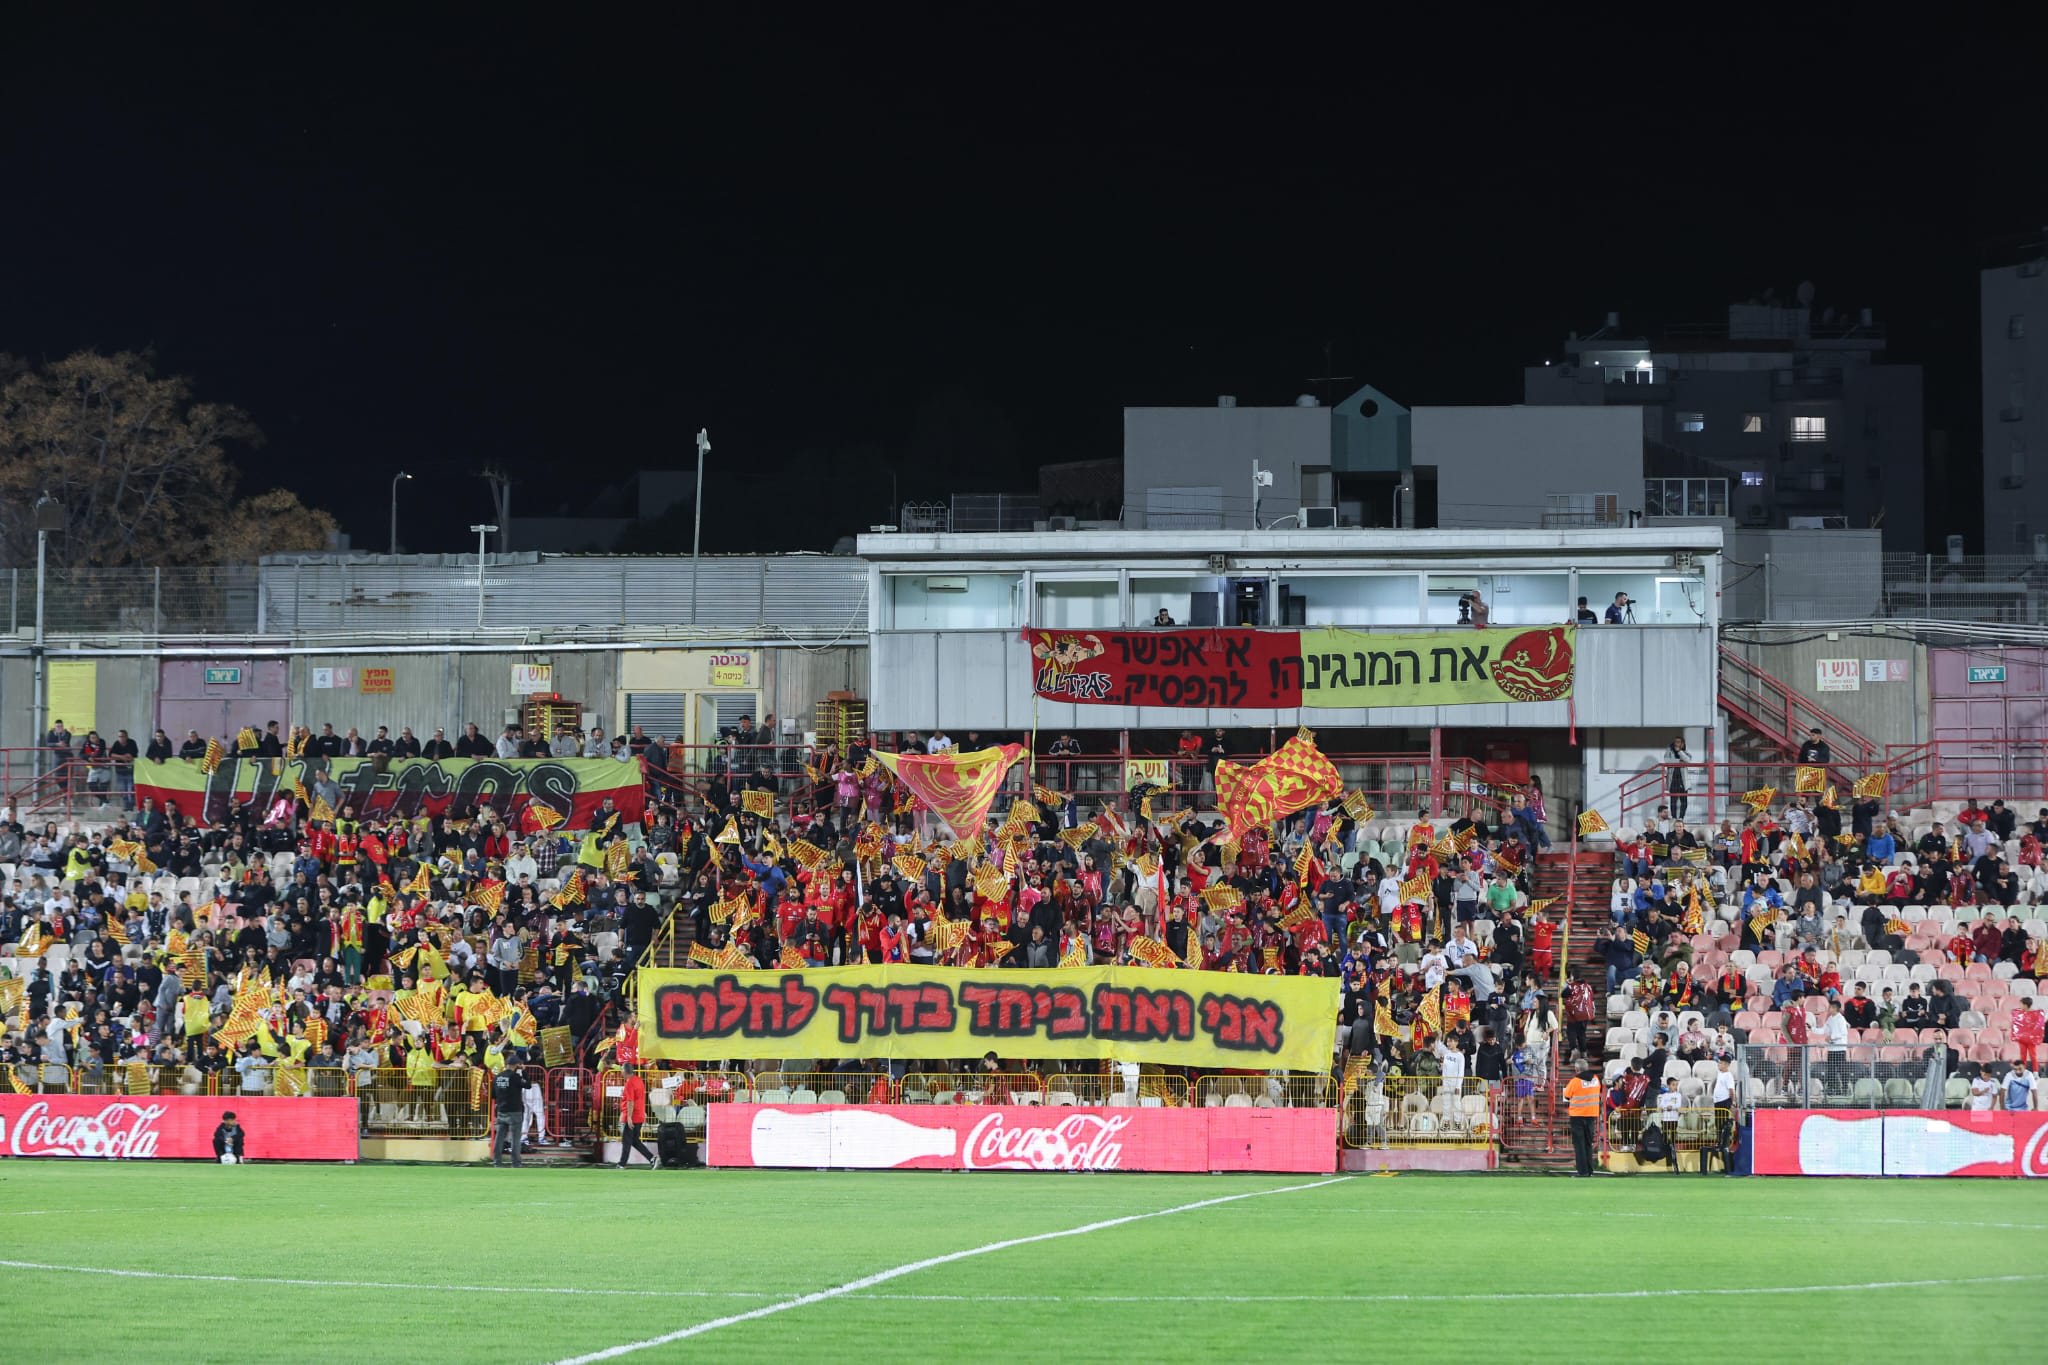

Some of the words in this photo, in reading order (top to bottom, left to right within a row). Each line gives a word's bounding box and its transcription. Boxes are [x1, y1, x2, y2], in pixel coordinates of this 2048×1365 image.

[1111, 635, 1208, 667] אפשר
[710, 655, 749, 666] כניסה
[1429, 646, 1490, 683] את
[319, 673, 327, 682] 4
[366, 668, 389, 679] חפץ
[528, 667, 551, 681] גוש
[715, 670, 722, 680] 4
[723, 672, 743, 681] כניסה
[1269, 650, 1421, 699] המנגינה!
[1832, 661, 1860, 678] גוש
[1872, 666, 1880, 677] 5
[363, 678, 392, 687] חשוד
[1036, 668, 1113, 699] ULTRAS
[1145, 762, 1168, 779] גוש
[655, 974, 819, 1038] לחלום
[822, 982, 957, 1043] בדרך
[958, 981, 1090, 1040] ביחד
[1091, 982, 1195, 1042] ואת
[1198, 991, 1284, 1054] אני
